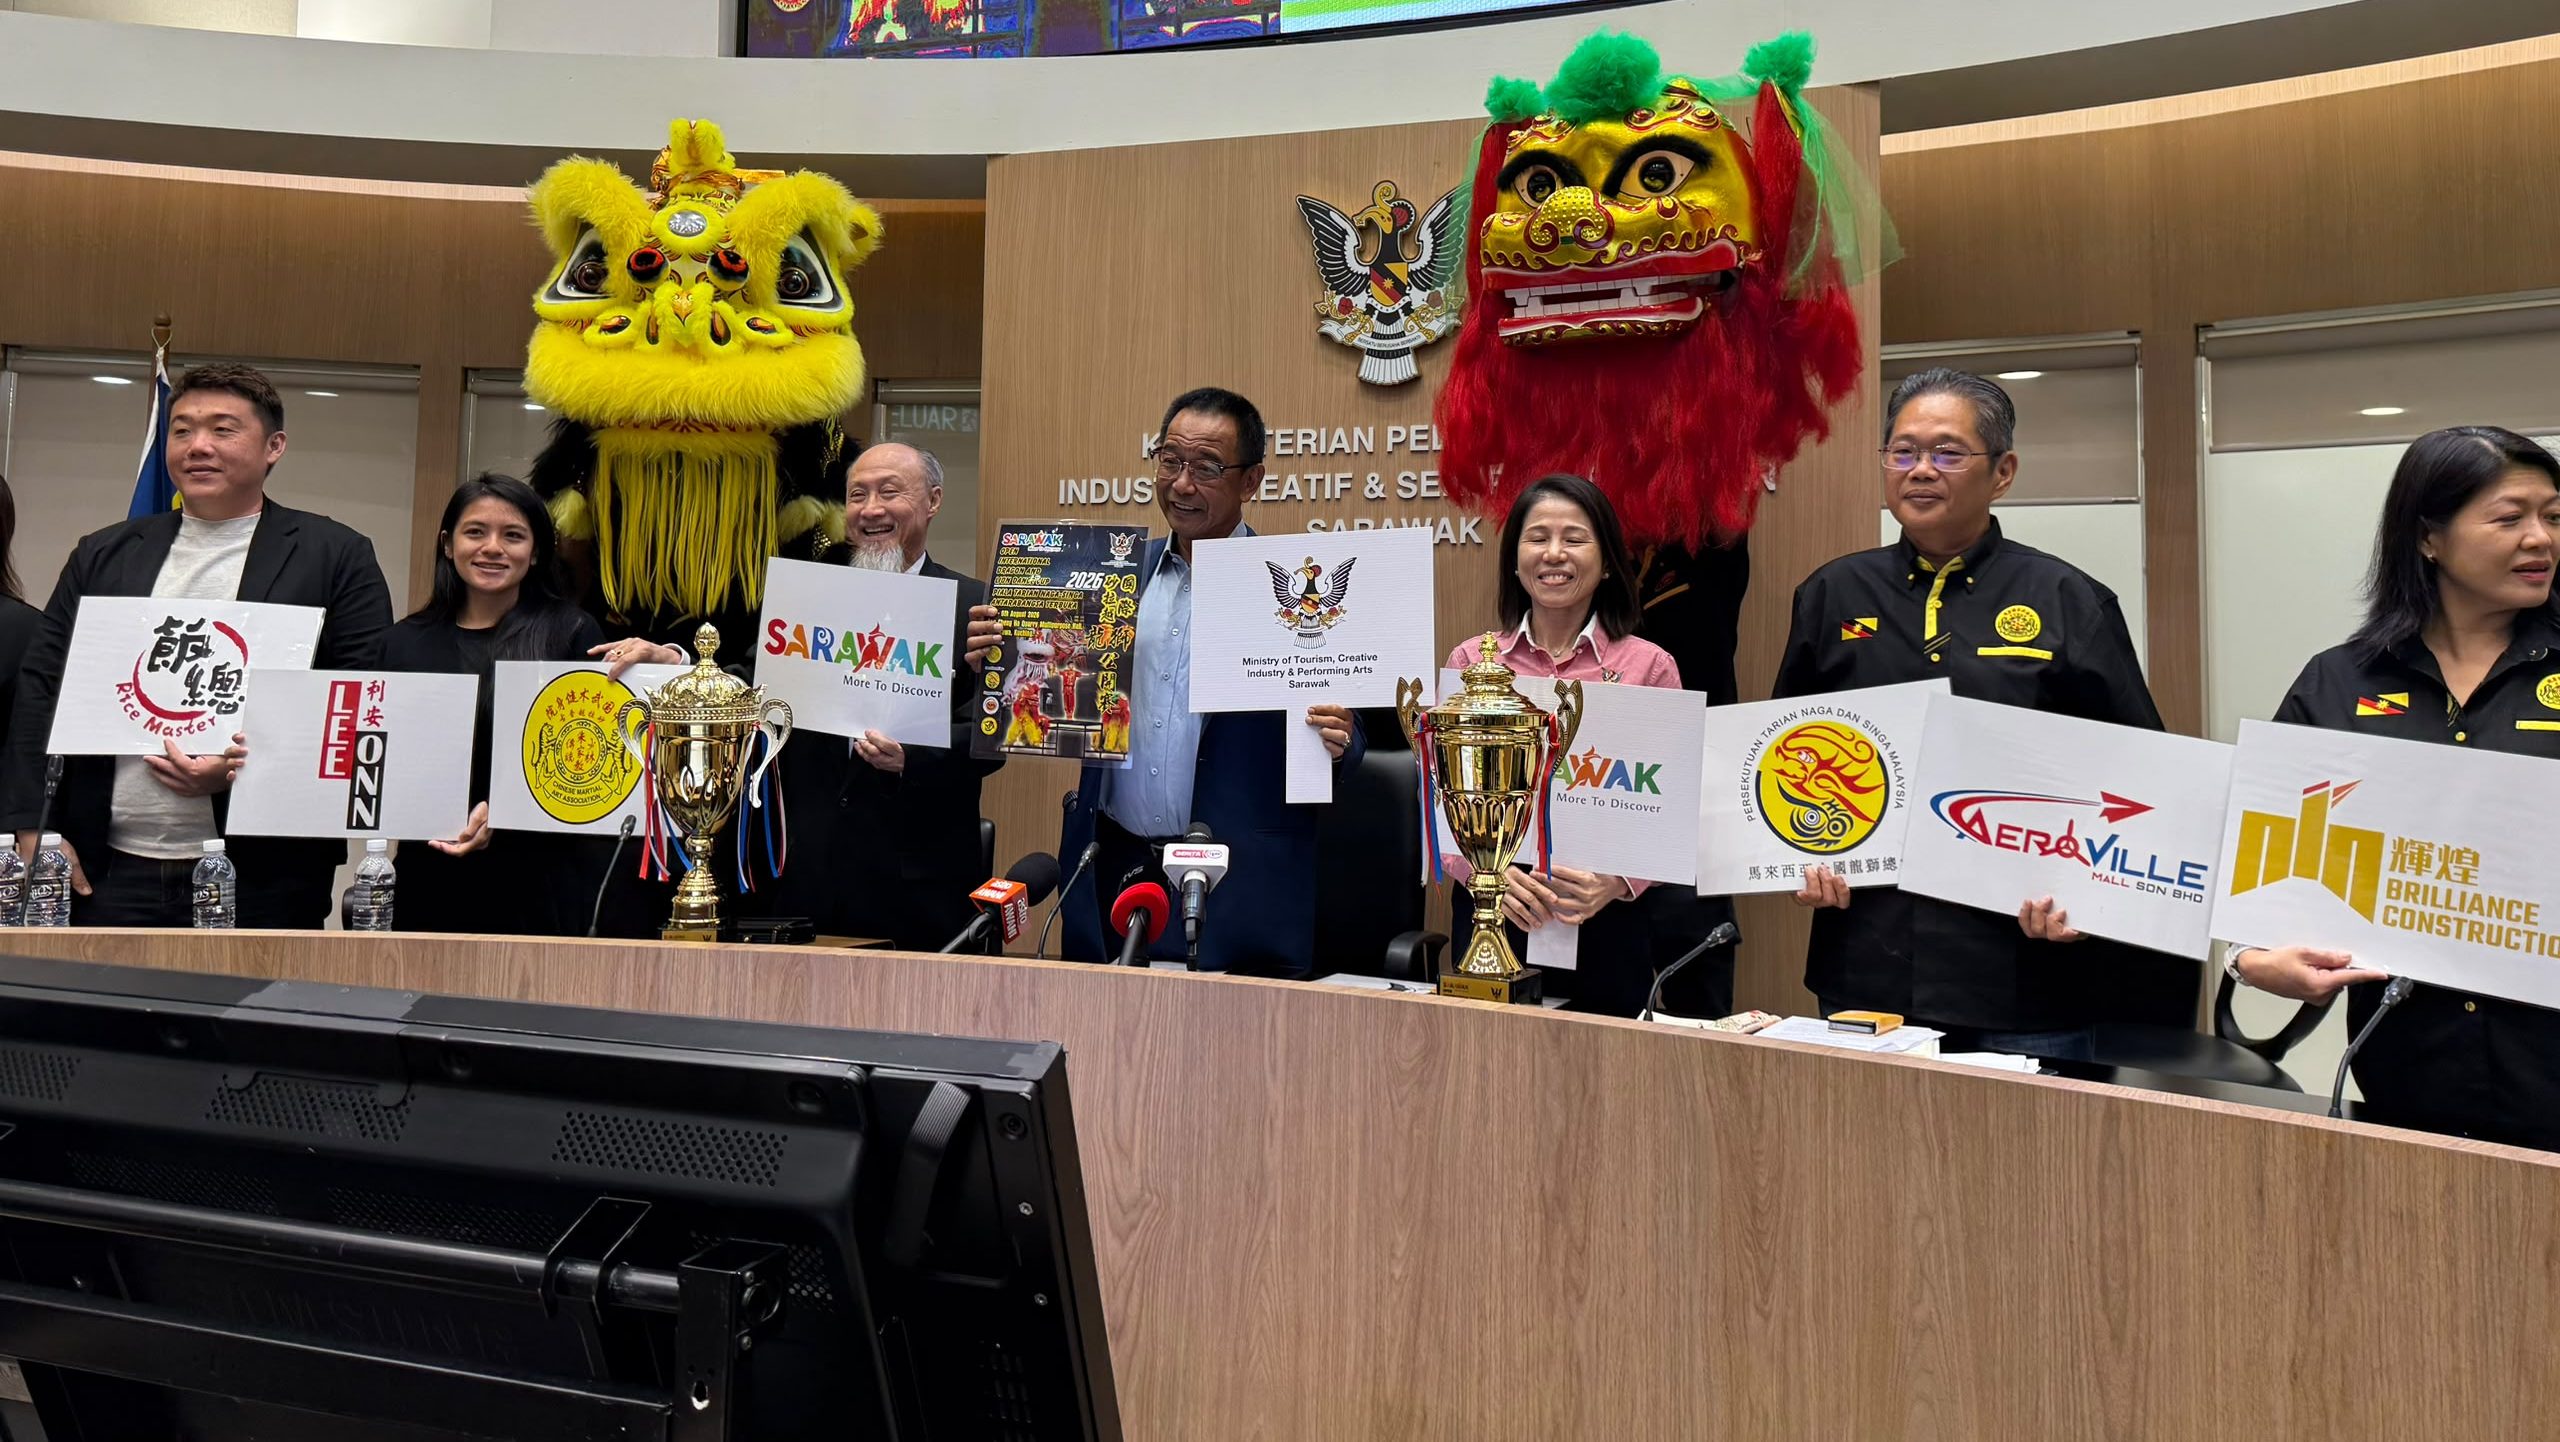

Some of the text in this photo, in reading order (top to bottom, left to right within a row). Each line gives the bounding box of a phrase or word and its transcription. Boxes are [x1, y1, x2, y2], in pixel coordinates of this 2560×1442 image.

[1058, 476, 1158, 504] INDUS
[1363, 471, 1387, 500] &
[1002, 531, 1063, 546] SARAWAK
[997, 557, 1051, 566] INTERNATIONAL
[1000, 547, 1019, 556] OPEN
[1025, 567, 1042, 575] AND
[1066, 571, 1105, 589] 2026
[990, 598, 1079, 610] ANTARABANGSA TERBUKA
[1013, 588, 1039, 598] TARIAN
[1038, 590, 1084, 600] NAGA-SINGA
[764, 619, 944, 679] SARAWAK
[1242, 653, 1378, 667] Ministry of Tourism, Creative
[1247, 665, 1373, 679] Industry & Performing Arts
[843, 675, 943, 698] More To Discover
[1288, 679, 1330, 689] Sarawak
[116, 682, 217, 737] Rice Master
[363, 679, 386, 727] 利安
[325, 684, 353, 776] LEE
[1552, 745, 1663, 796] AWAK
[1740, 706, 1907, 822] PERSEKUTUAN TARIAN NAGA DAN SINGA MALAYSIA
[352, 734, 384, 827] ONN
[553, 780, 602, 795] CHINESE MARTIAL
[551, 790, 602, 804] ART ASSOCIATION
[1556, 793, 1662, 813] More To Discover
[2389, 836, 2480, 887] 輝煌
[2091, 871, 2204, 904] MALL SDN BHD
[2386, 878, 2540, 927] BRILLIANCE
